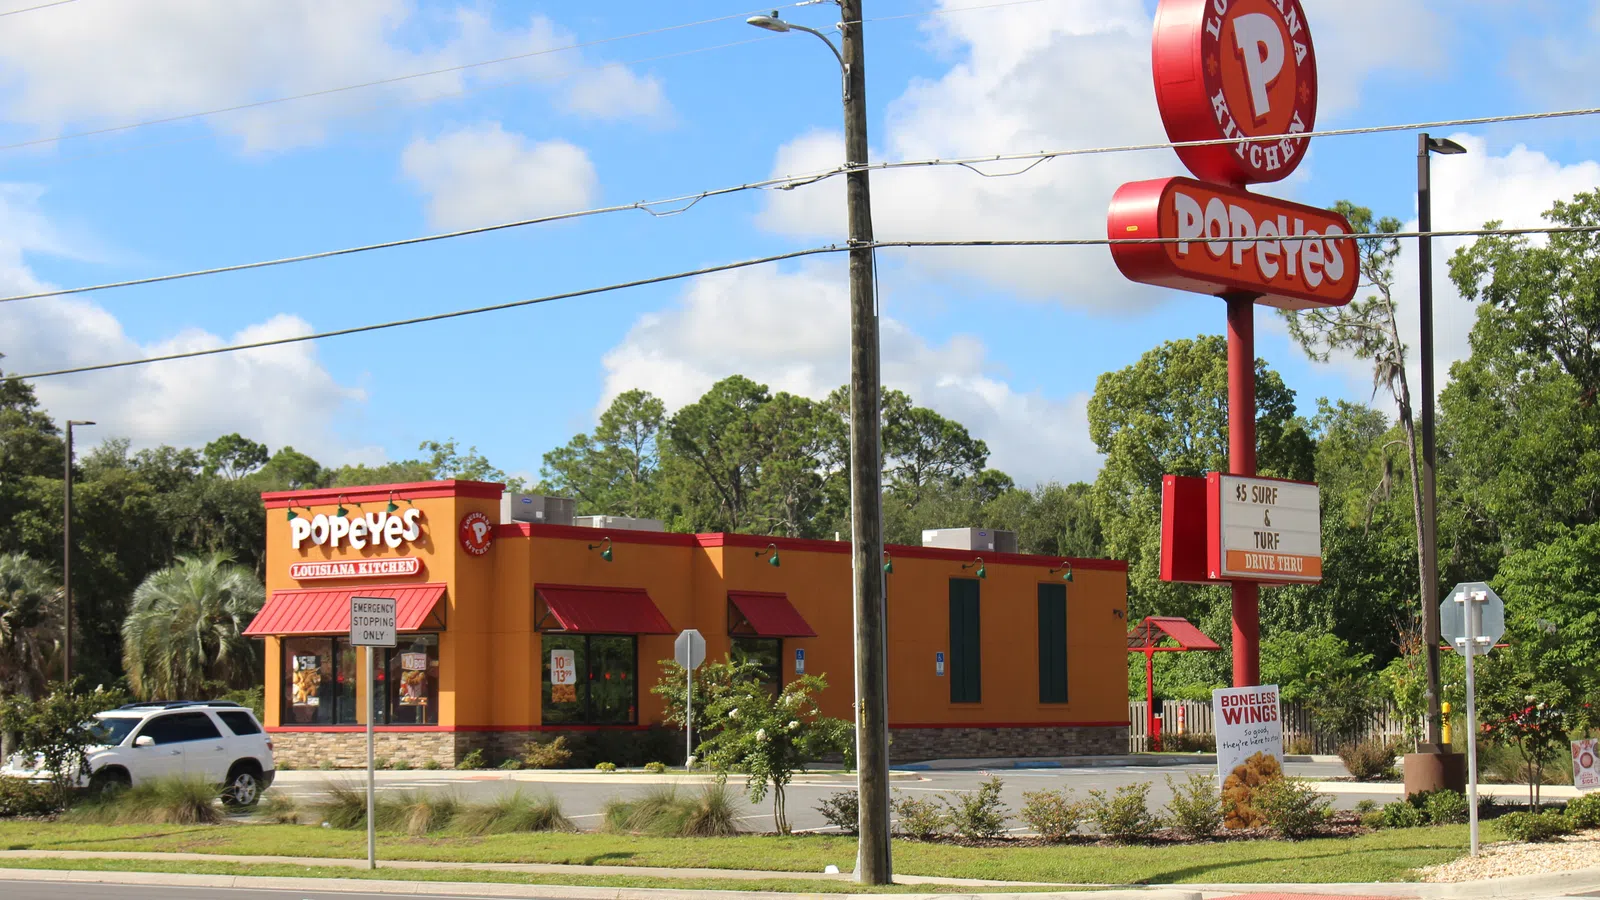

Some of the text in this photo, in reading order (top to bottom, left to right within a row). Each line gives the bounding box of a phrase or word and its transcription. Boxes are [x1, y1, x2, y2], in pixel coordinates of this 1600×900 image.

[1233, 13, 1285, 117] P
[1211, 88, 1305, 171] KITCHEN
[1236, 484, 1278, 505] $5 SURF
[1264, 509, 1271, 527] &
[472, 522, 487, 544] P
[1254, 531, 1280, 550] TURF
[293, 560, 415, 577] LOUISIANA KITCHEN
[1245, 553, 1303, 573] DRIVE THRU
[353, 603, 394, 613] EMERGENCY
[353, 616, 394, 627] STOPPING
[363, 630, 385, 640] ONLY
[555, 656, 564, 669] 10
[1221, 692, 1276, 707] BONELESS
[1222, 704, 1278, 725] WINGS
[1252, 726, 1269, 739] good,
[1223, 739, 1249, 751] they're
[1249, 737, 1264, 746] here
